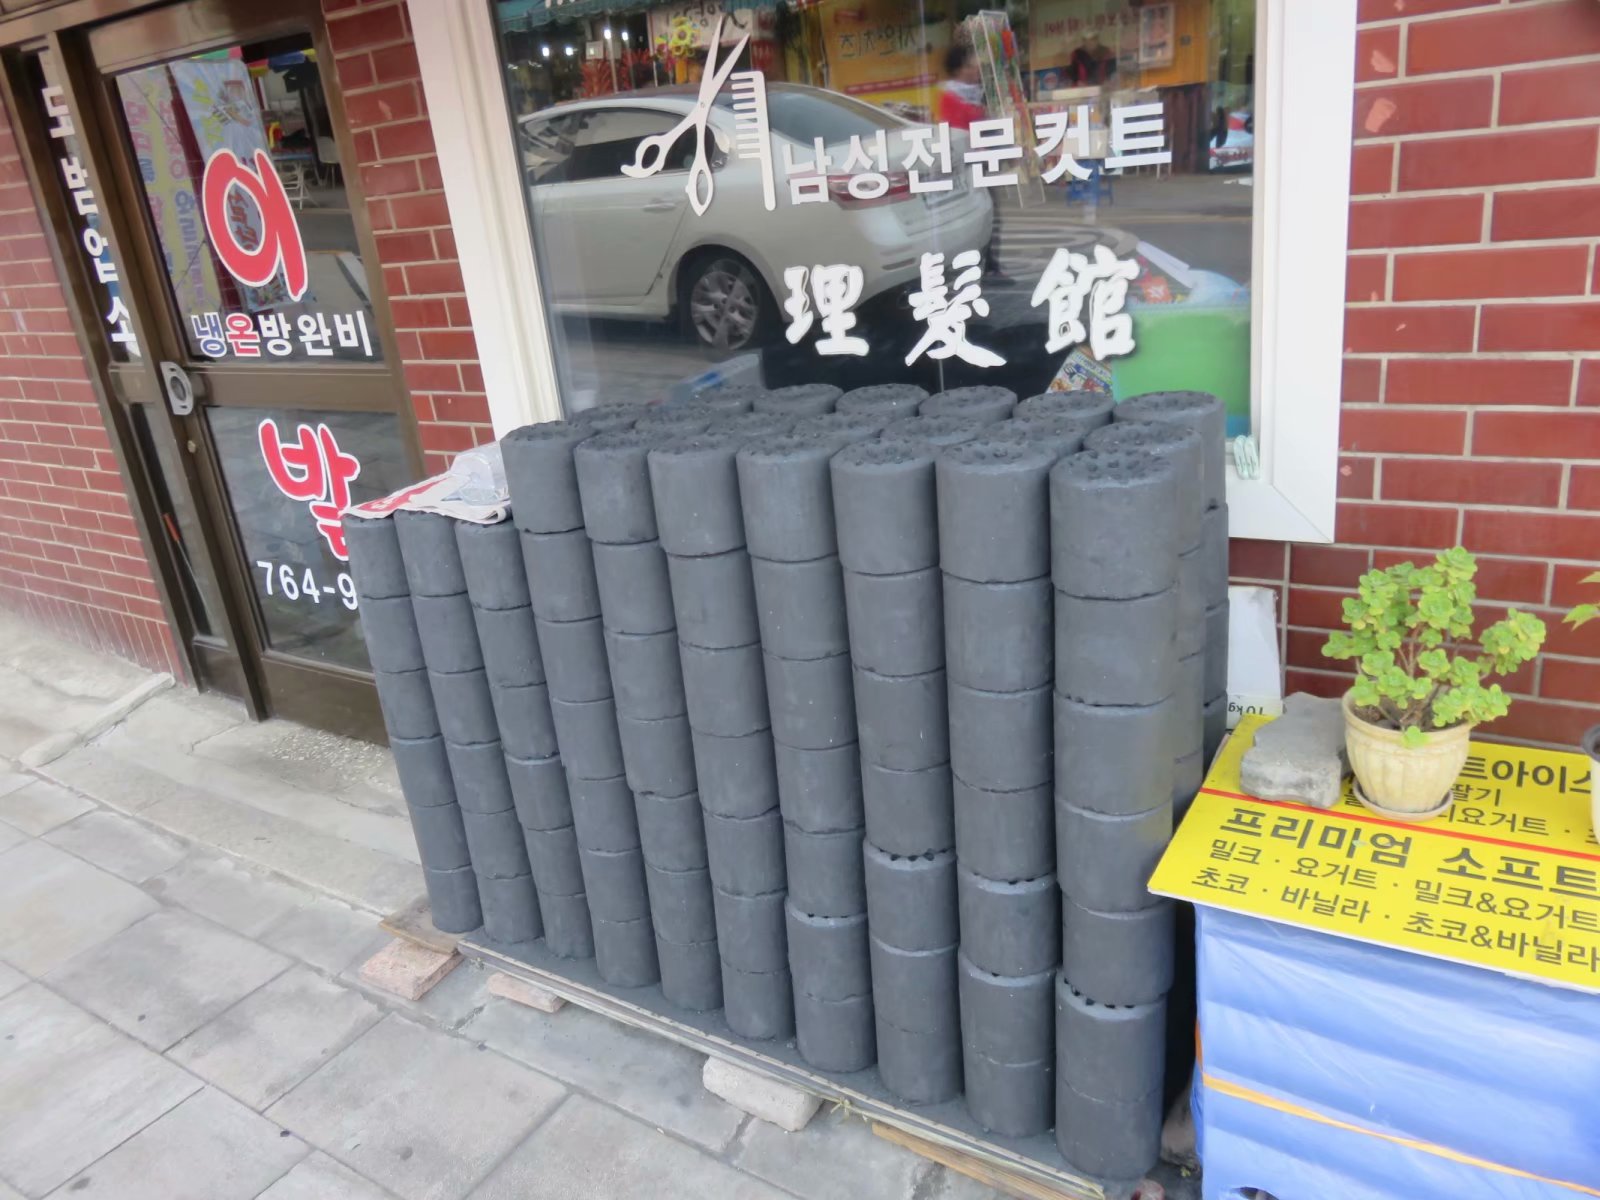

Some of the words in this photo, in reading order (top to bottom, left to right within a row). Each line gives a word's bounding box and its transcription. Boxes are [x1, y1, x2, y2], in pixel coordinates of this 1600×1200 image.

[784, 246, 1139, 368] 理髮館
[1191, 867, 1250, 895] 초코
[1280, 886, 1371, 924] 바닐라
[1403, 911, 1600, 973] 초코&바닐라
[1209, 839, 1263, 865] 밀크
[1290, 857, 1378, 890] 요거트
[1415, 879, 1600, 934] 밀크&요거트
[1437, 848, 1600, 901] 소프트
